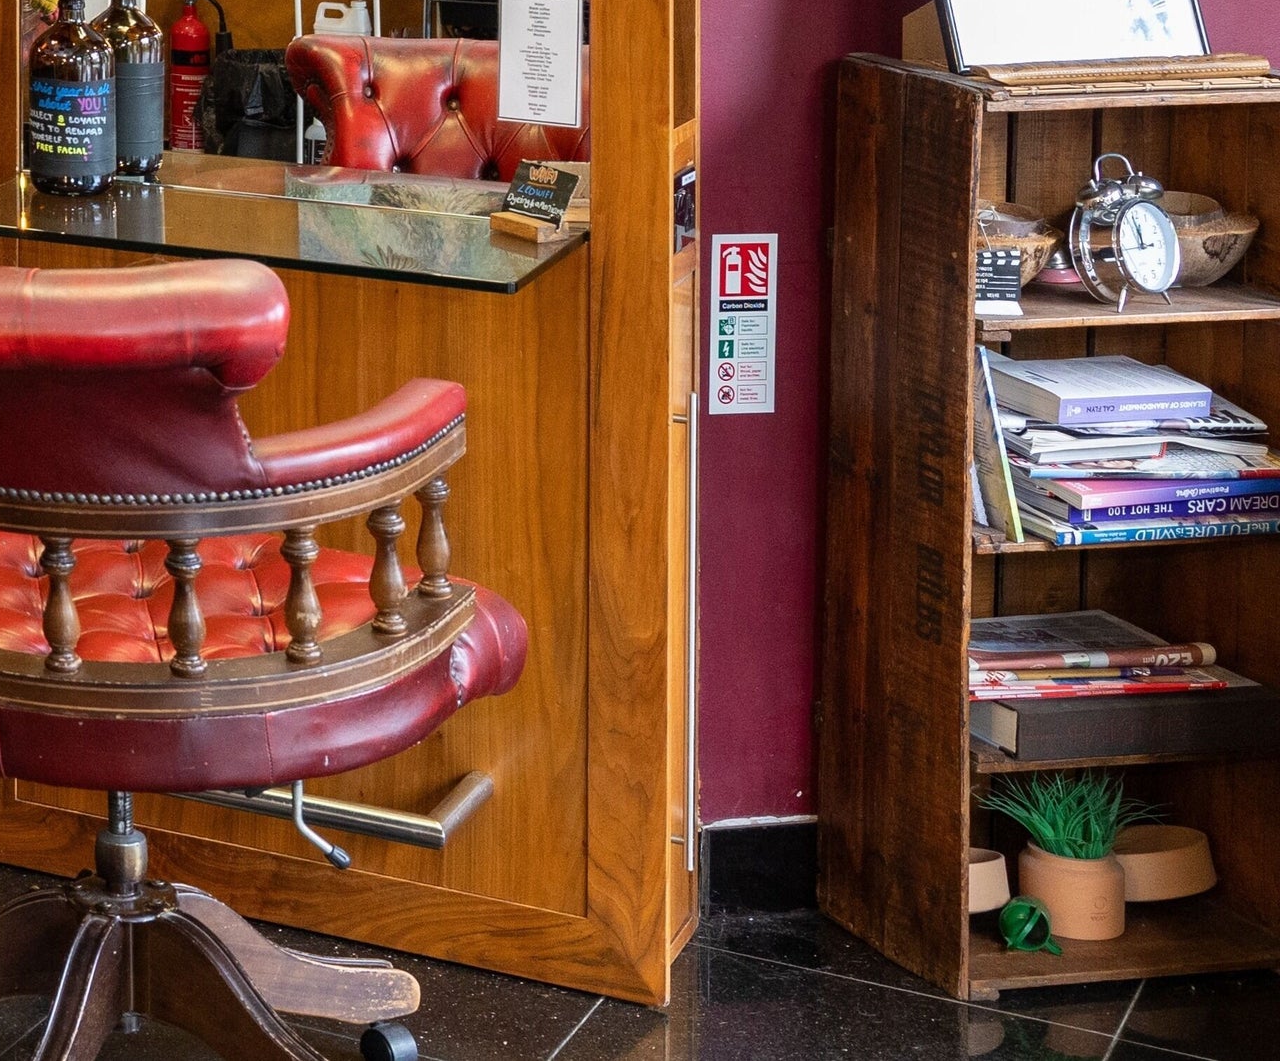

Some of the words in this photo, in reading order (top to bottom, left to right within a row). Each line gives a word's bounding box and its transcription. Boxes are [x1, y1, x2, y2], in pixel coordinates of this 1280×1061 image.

[68, 116, 107, 125] LOYALTY
[47, 124, 60, 134] TO
[64, 126, 103, 136] REWARD
[65, 136, 79, 145] TO
[82, 136, 91, 144] A
[35, 141, 54, 153] FREE
[57, 145, 88, 155] FACIAL
[721, 302, 743, 310] Carbon
[743, 301, 765, 309] Dioxide
[1086, 404, 1102, 414] FLYN
[1102, 404, 1116, 413] CAL
[1118, 402, 1170, 413] ABANDONMENT
[1169, 401, 1180, 410] OF
[1180, 399, 1207, 409] ISLANDS
[1198, 485, 1230, 496] Festival
[1153, 502, 1174, 514] THE
[1186, 498, 1228, 515] CARS
[1231, 494, 1280, 511] DREAM
[1107, 506, 1127, 517] 100
[1129, 504, 1151, 516] HOT
[1183, 523, 1251, 539] FUTURE
